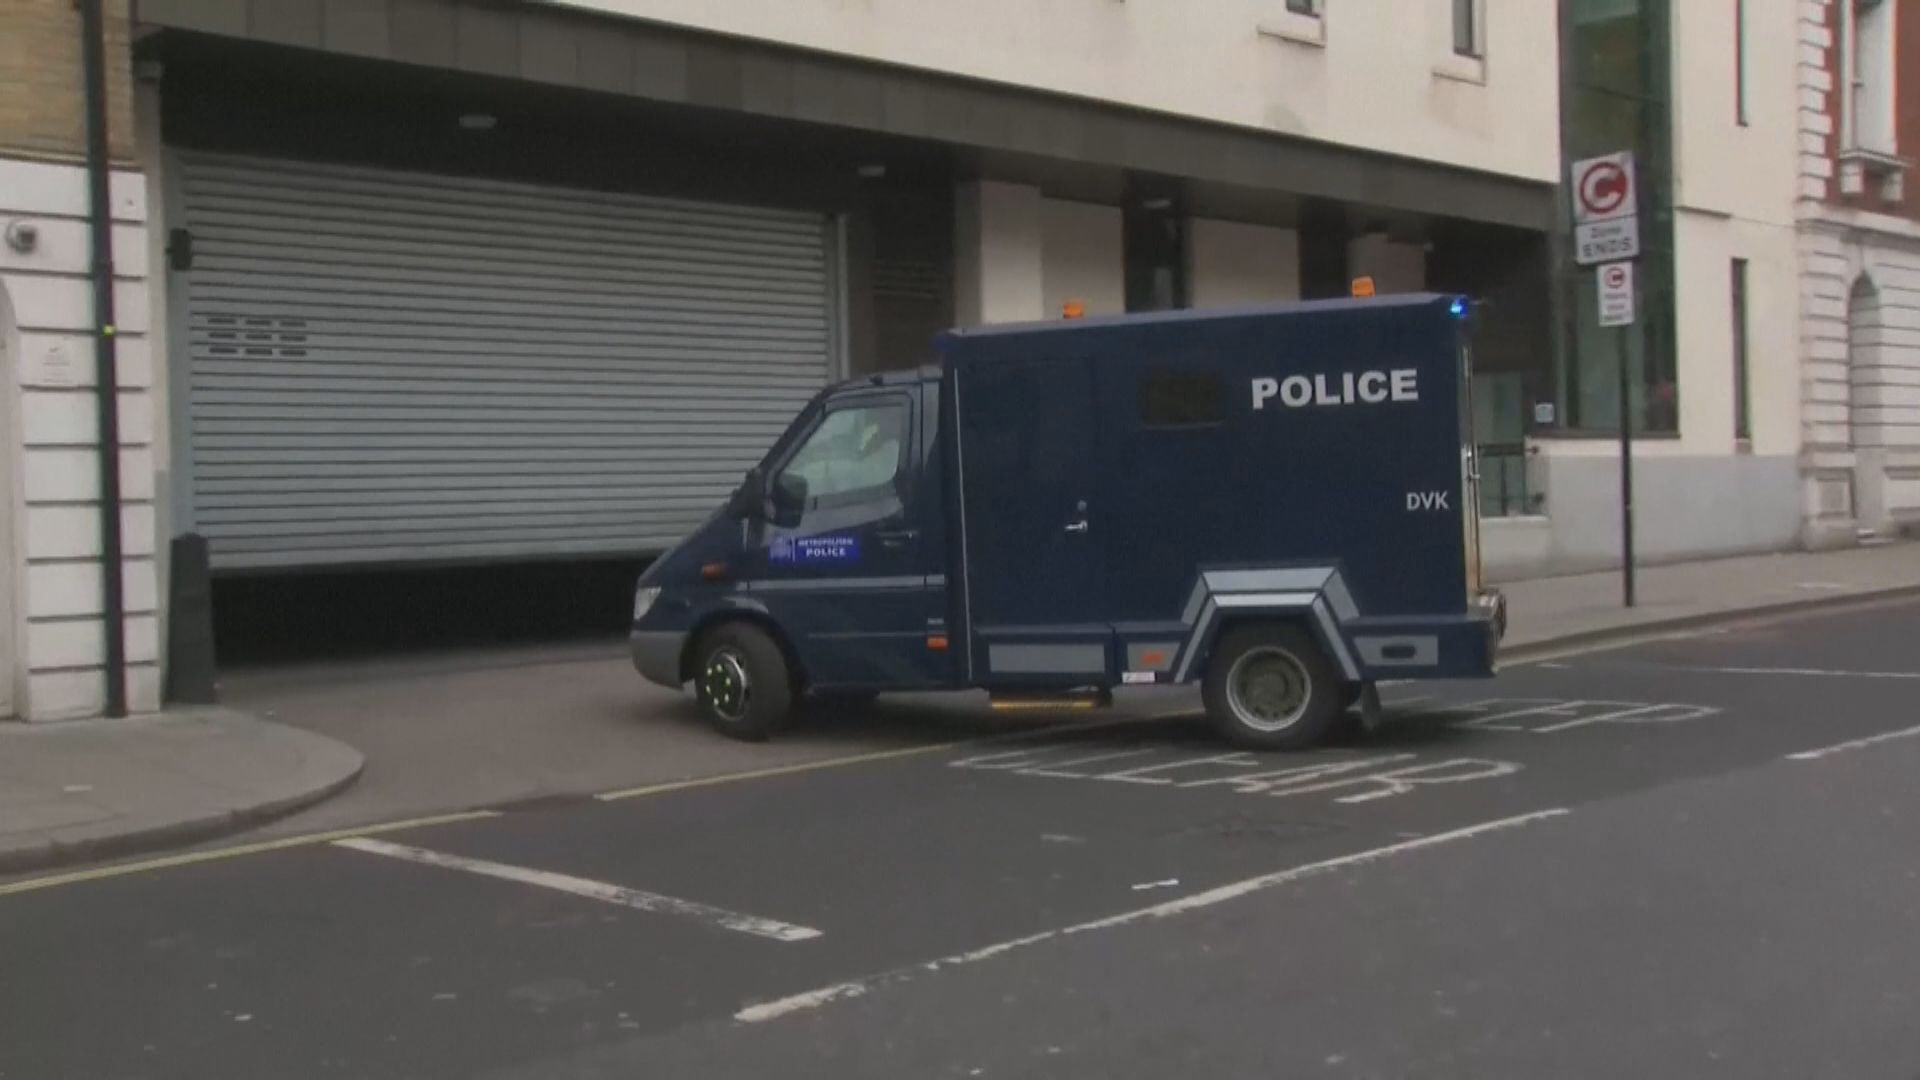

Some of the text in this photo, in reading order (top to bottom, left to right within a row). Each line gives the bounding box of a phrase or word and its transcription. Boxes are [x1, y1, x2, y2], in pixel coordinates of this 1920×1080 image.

[1583, 236, 1632, 258] ENDS
[1251, 368, 1419, 409] POLICE
[1406, 491, 1449, 510] DVK
[806, 547, 846, 558] POLICE
